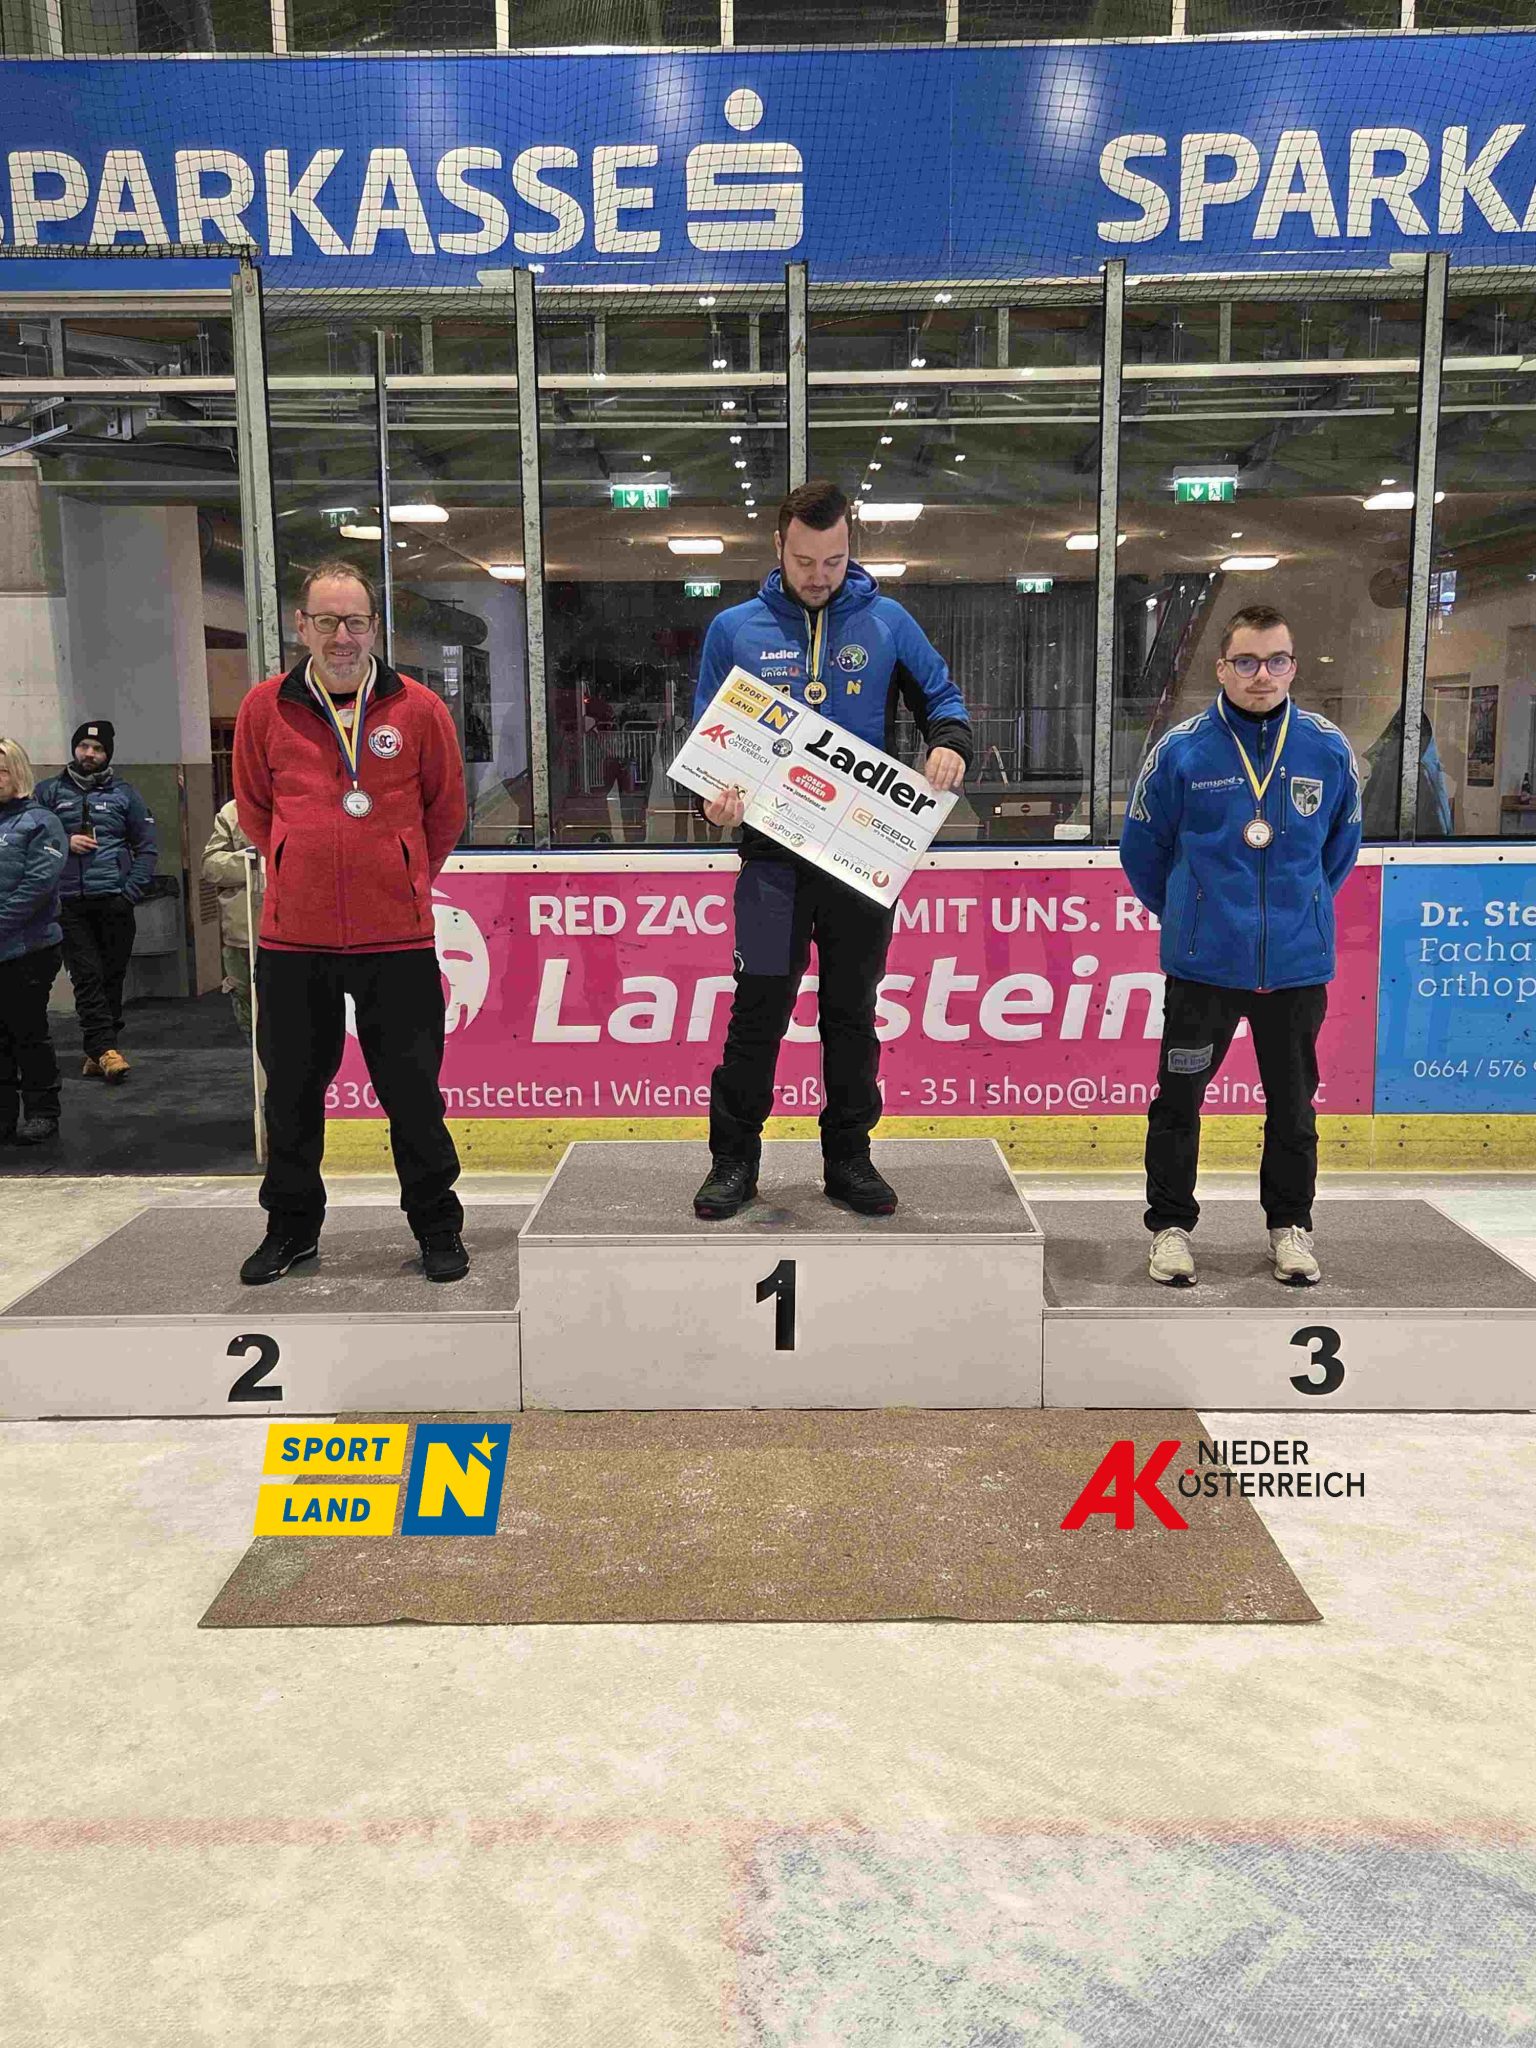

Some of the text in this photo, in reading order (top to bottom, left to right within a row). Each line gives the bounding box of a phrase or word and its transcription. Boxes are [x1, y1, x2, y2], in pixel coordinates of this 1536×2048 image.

[1097, 124, 1536, 243] SPARK
[0, 145, 660, 257] PARKASSE
[760, 650, 799, 660] Ladler
[730, 697, 754, 714] LAND
[738, 683, 767, 702] SPORT
[699, 724, 734, 749] AK
[736, 734, 762, 752] NIEDER
[801, 772, 826, 790] JOSEF
[804, 729, 936, 815] Ladler
[794, 775, 826, 798] STEINER
[760, 814, 793, 838] GlasPro
[870, 819, 918, 851] GEBOL
[832, 853, 870, 880] union
[530, 895, 626, 936] RED
[637, 895, 727, 936] ZAC
[892, 898, 977, 933] MIT
[991, 896, 1100, 933] UNS.
[1420, 901, 1469, 927] Dr.
[1419, 936, 1536, 962] Facha
[1418, 971, 1536, 1003] orthop
[1413, 1059, 1469, 1078] 0664
[1488, 1059, 1527, 1078] 576
[438, 1081, 582, 1108] mstetten
[610, 1079, 711, 1107] Wiene
[921, 1079, 957, 1105] 35
[756, 1259, 797, 1352] 1
[226, 1333, 283, 1402] 2
[1289, 1325, 1345, 1395] 3
